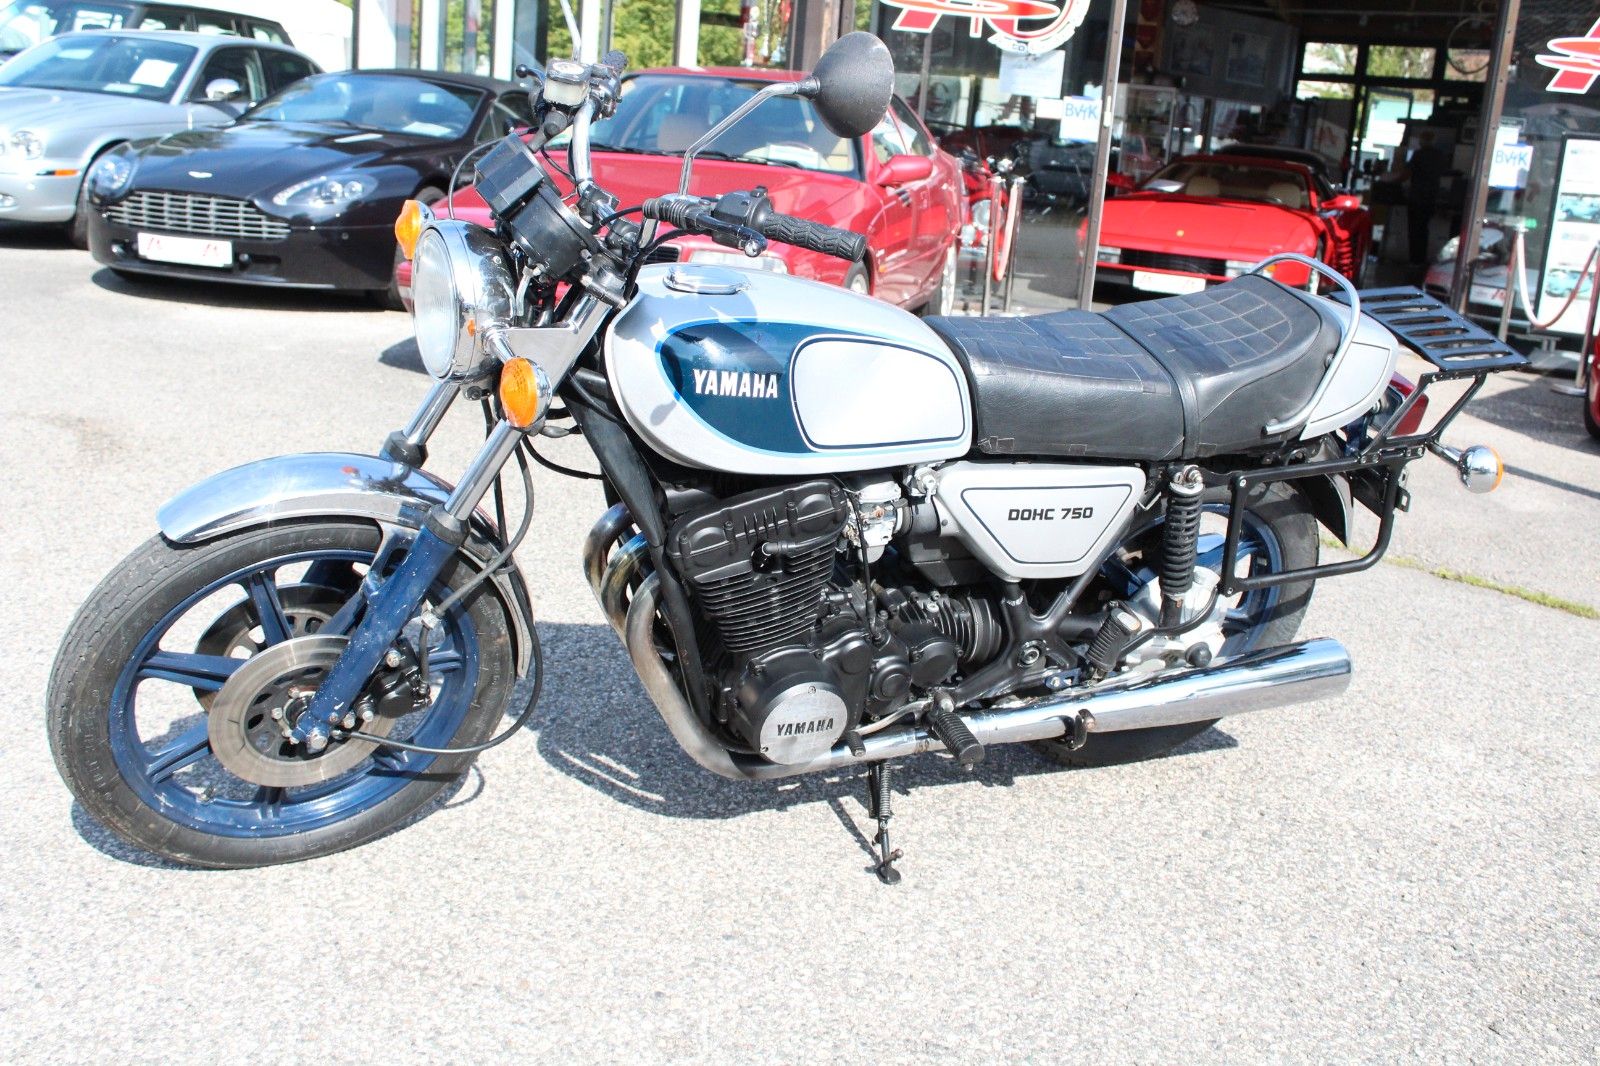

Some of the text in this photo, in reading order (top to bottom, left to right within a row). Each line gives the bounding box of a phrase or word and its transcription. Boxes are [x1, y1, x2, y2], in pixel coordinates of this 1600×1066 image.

[693, 368, 778, 398] YAMAHA
[1008, 507, 1093, 521] DOHC 750
[777, 717, 834, 736] YAMAHA
